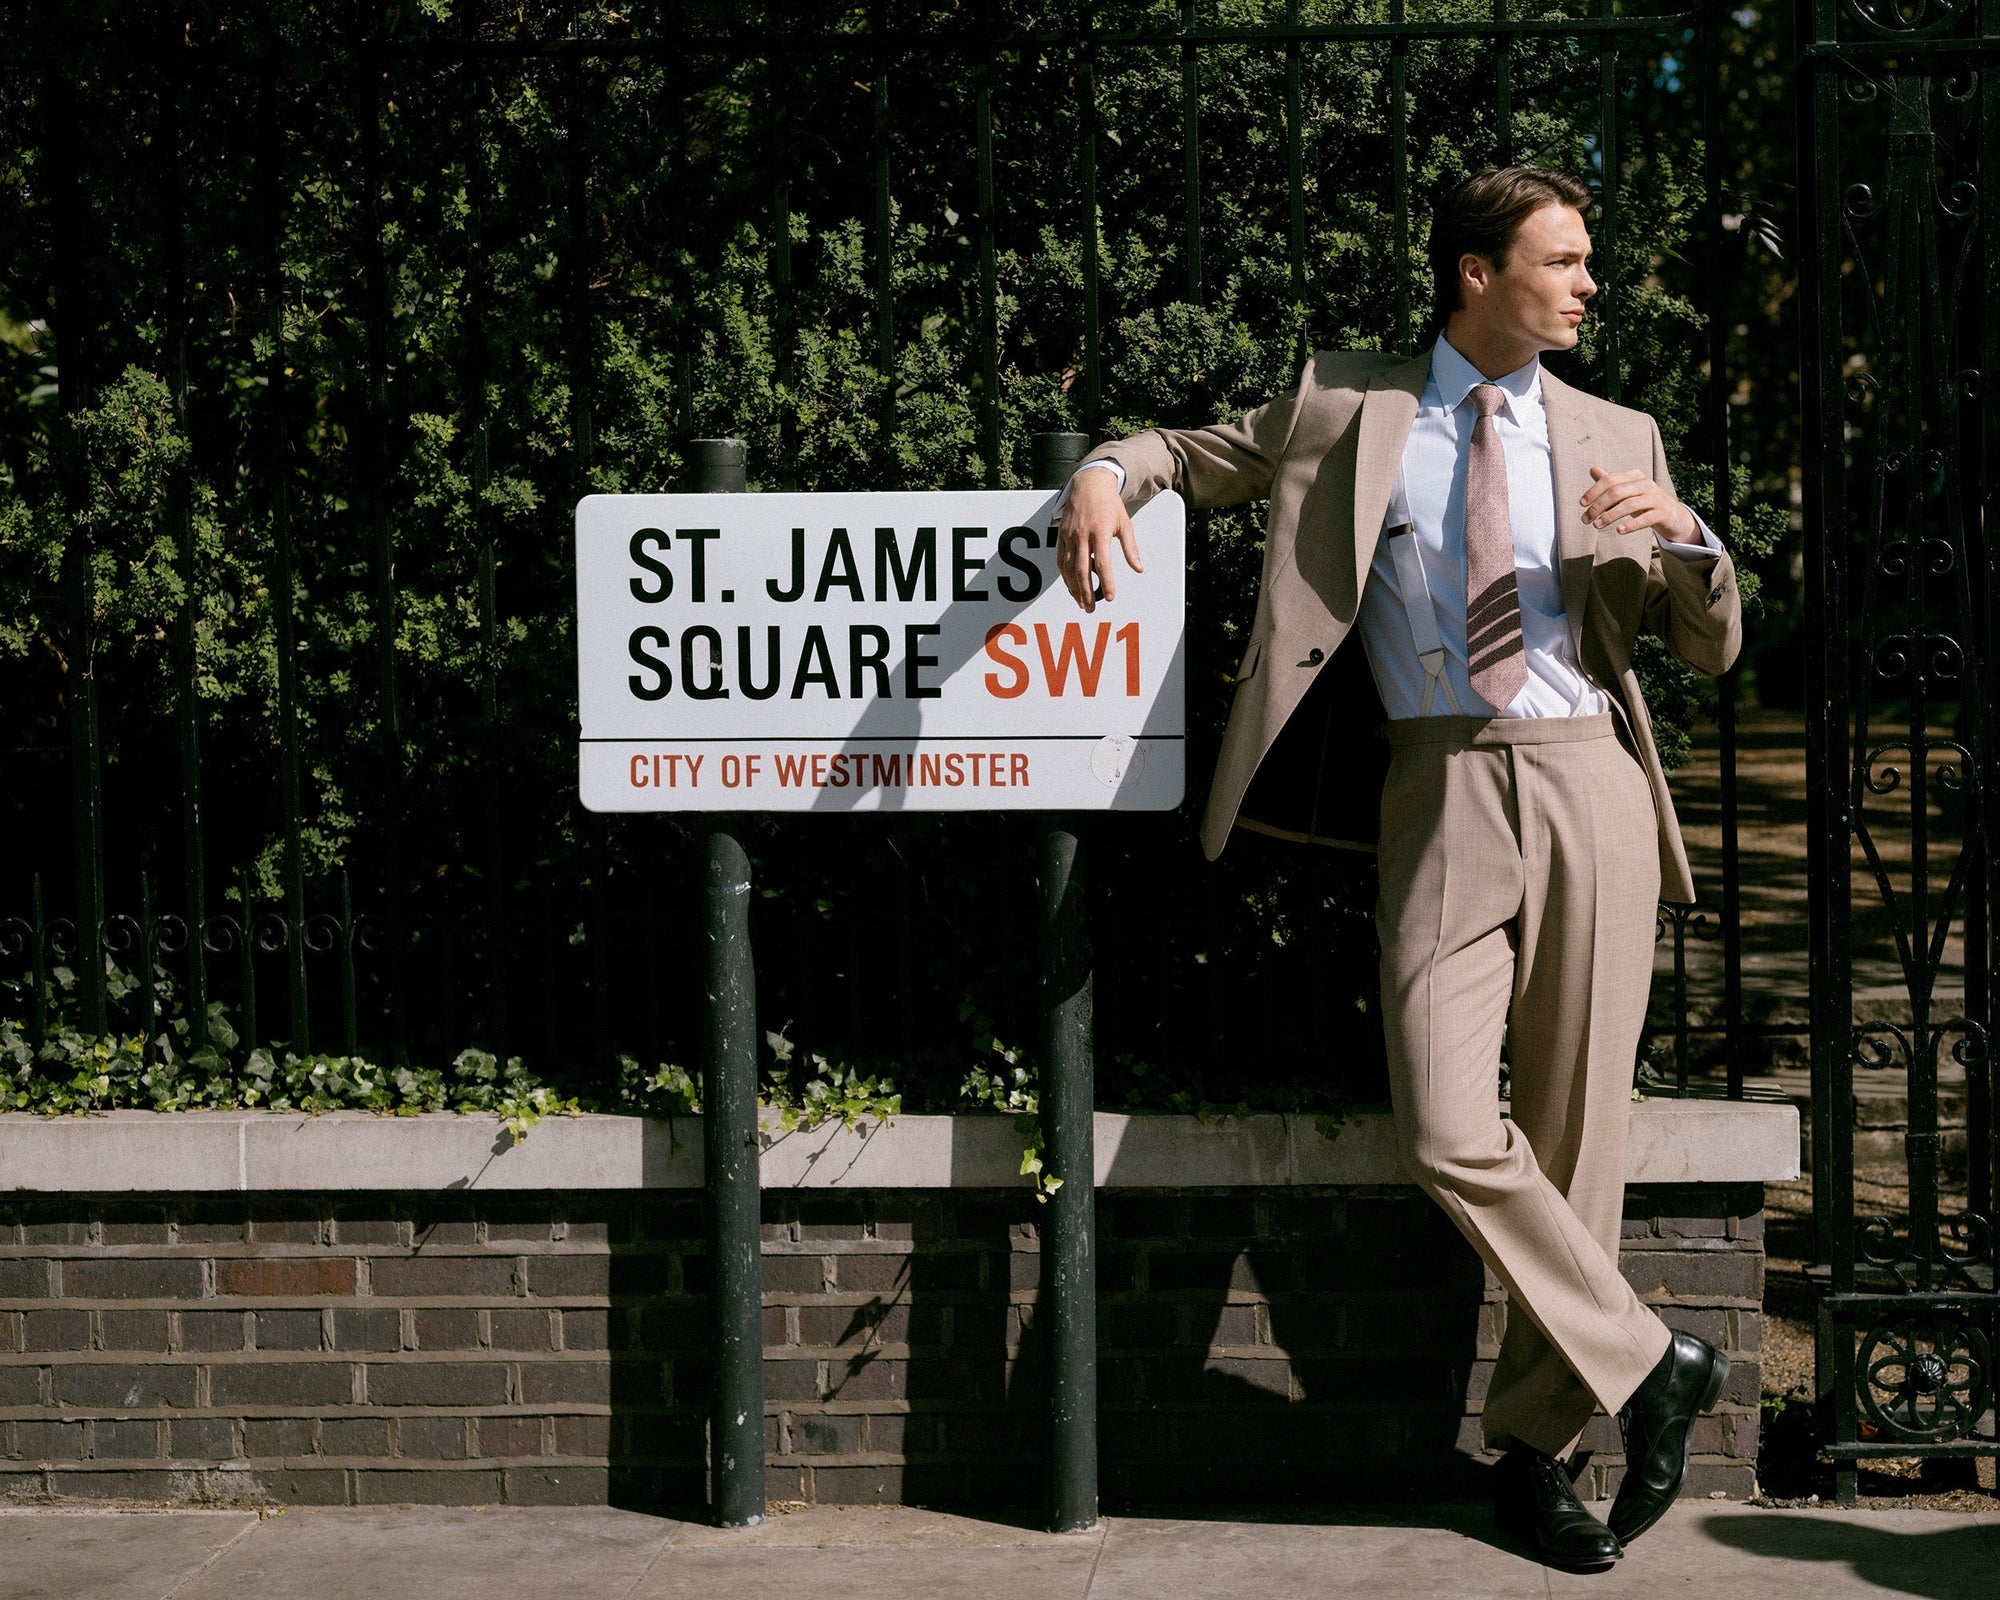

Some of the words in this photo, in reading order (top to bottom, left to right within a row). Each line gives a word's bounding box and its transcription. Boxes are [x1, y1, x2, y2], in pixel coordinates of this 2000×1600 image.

[629, 527, 735, 604] ST.
[765, 526, 1107, 604] JAMES'
[628, 624, 942, 701] SQUARE
[983, 621, 1141, 700] SW1
[630, 754, 704, 788] CITY
[720, 754, 761, 788] OF
[774, 753, 1030, 788] WESTMINSTER
